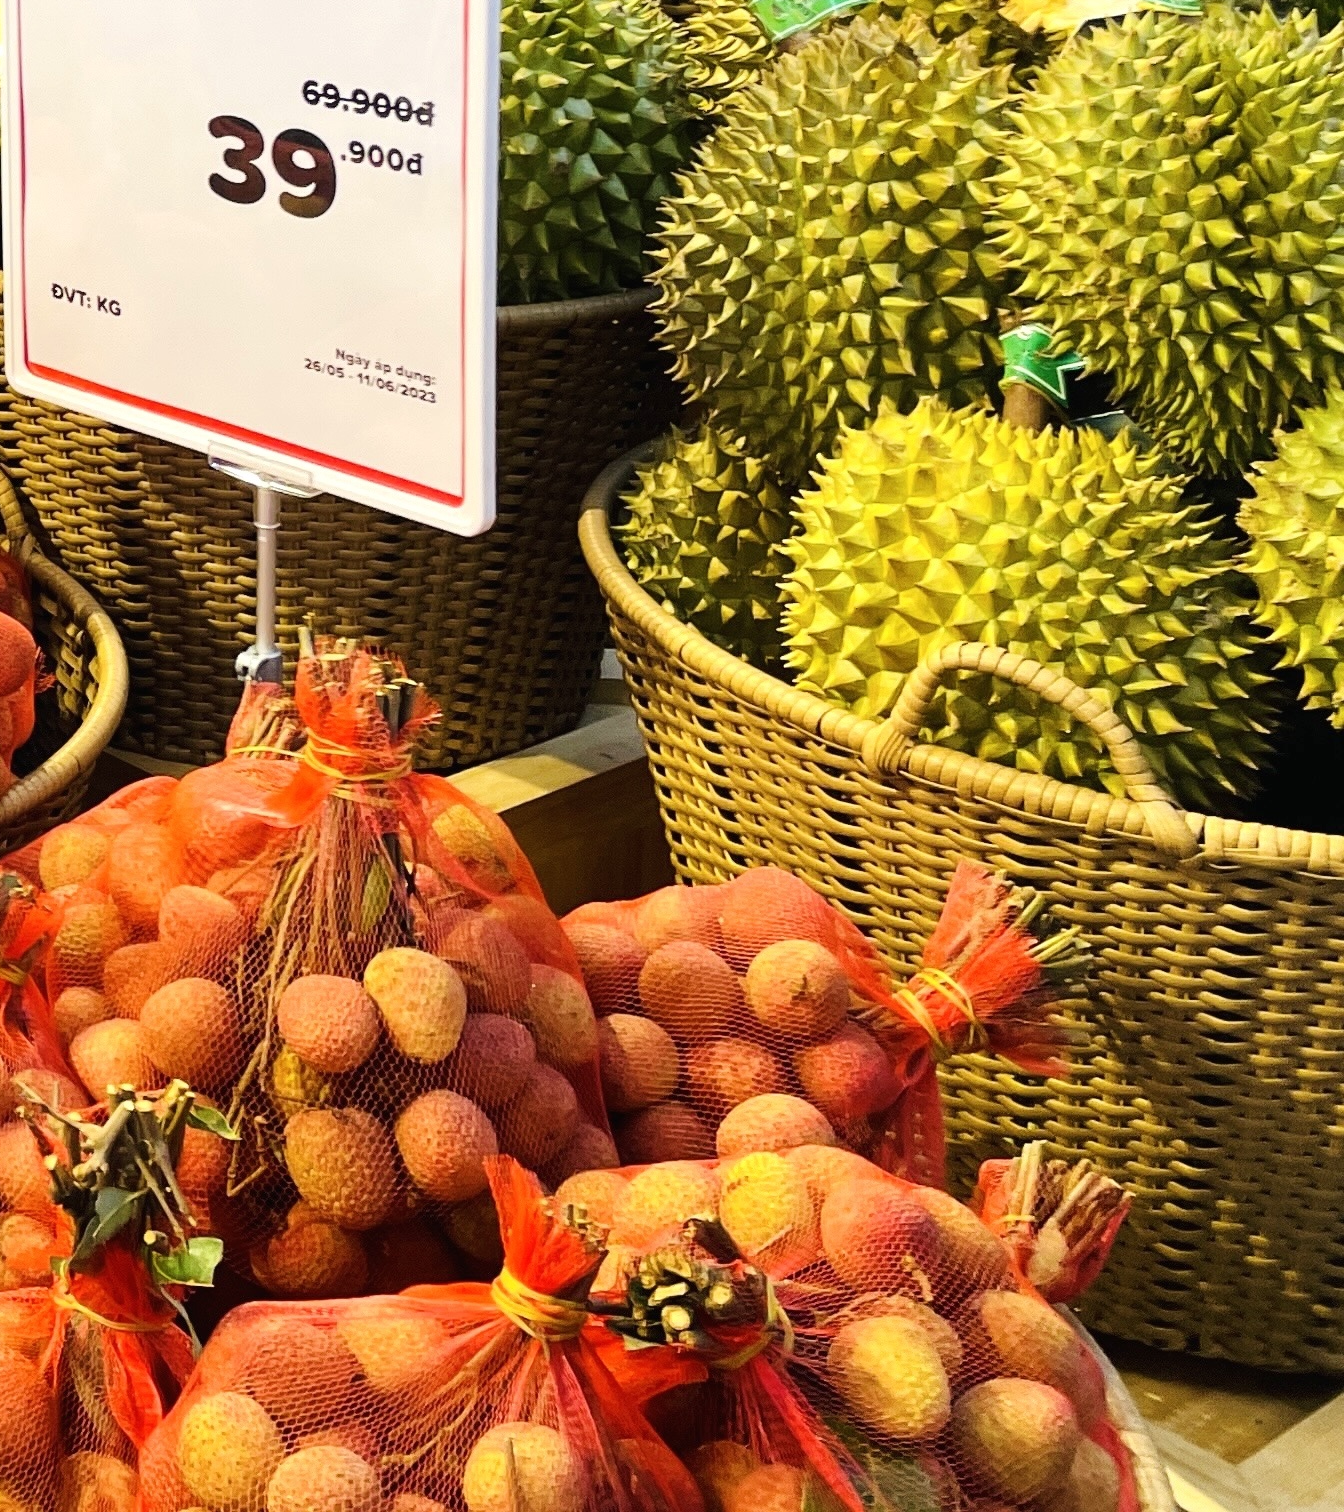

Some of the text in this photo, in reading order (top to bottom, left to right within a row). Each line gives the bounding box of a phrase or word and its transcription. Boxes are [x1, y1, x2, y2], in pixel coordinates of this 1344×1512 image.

[302, 80, 434, 127] 69.900đ
[208, 115, 337, 219] 39
[51, 283, 122, 317] ĐVT: KG
[304, 358, 345, 379] 26/05
[357, 373, 437, 404] 11/06/2023
[335, 348, 437, 387] Ngày áp dụng:
